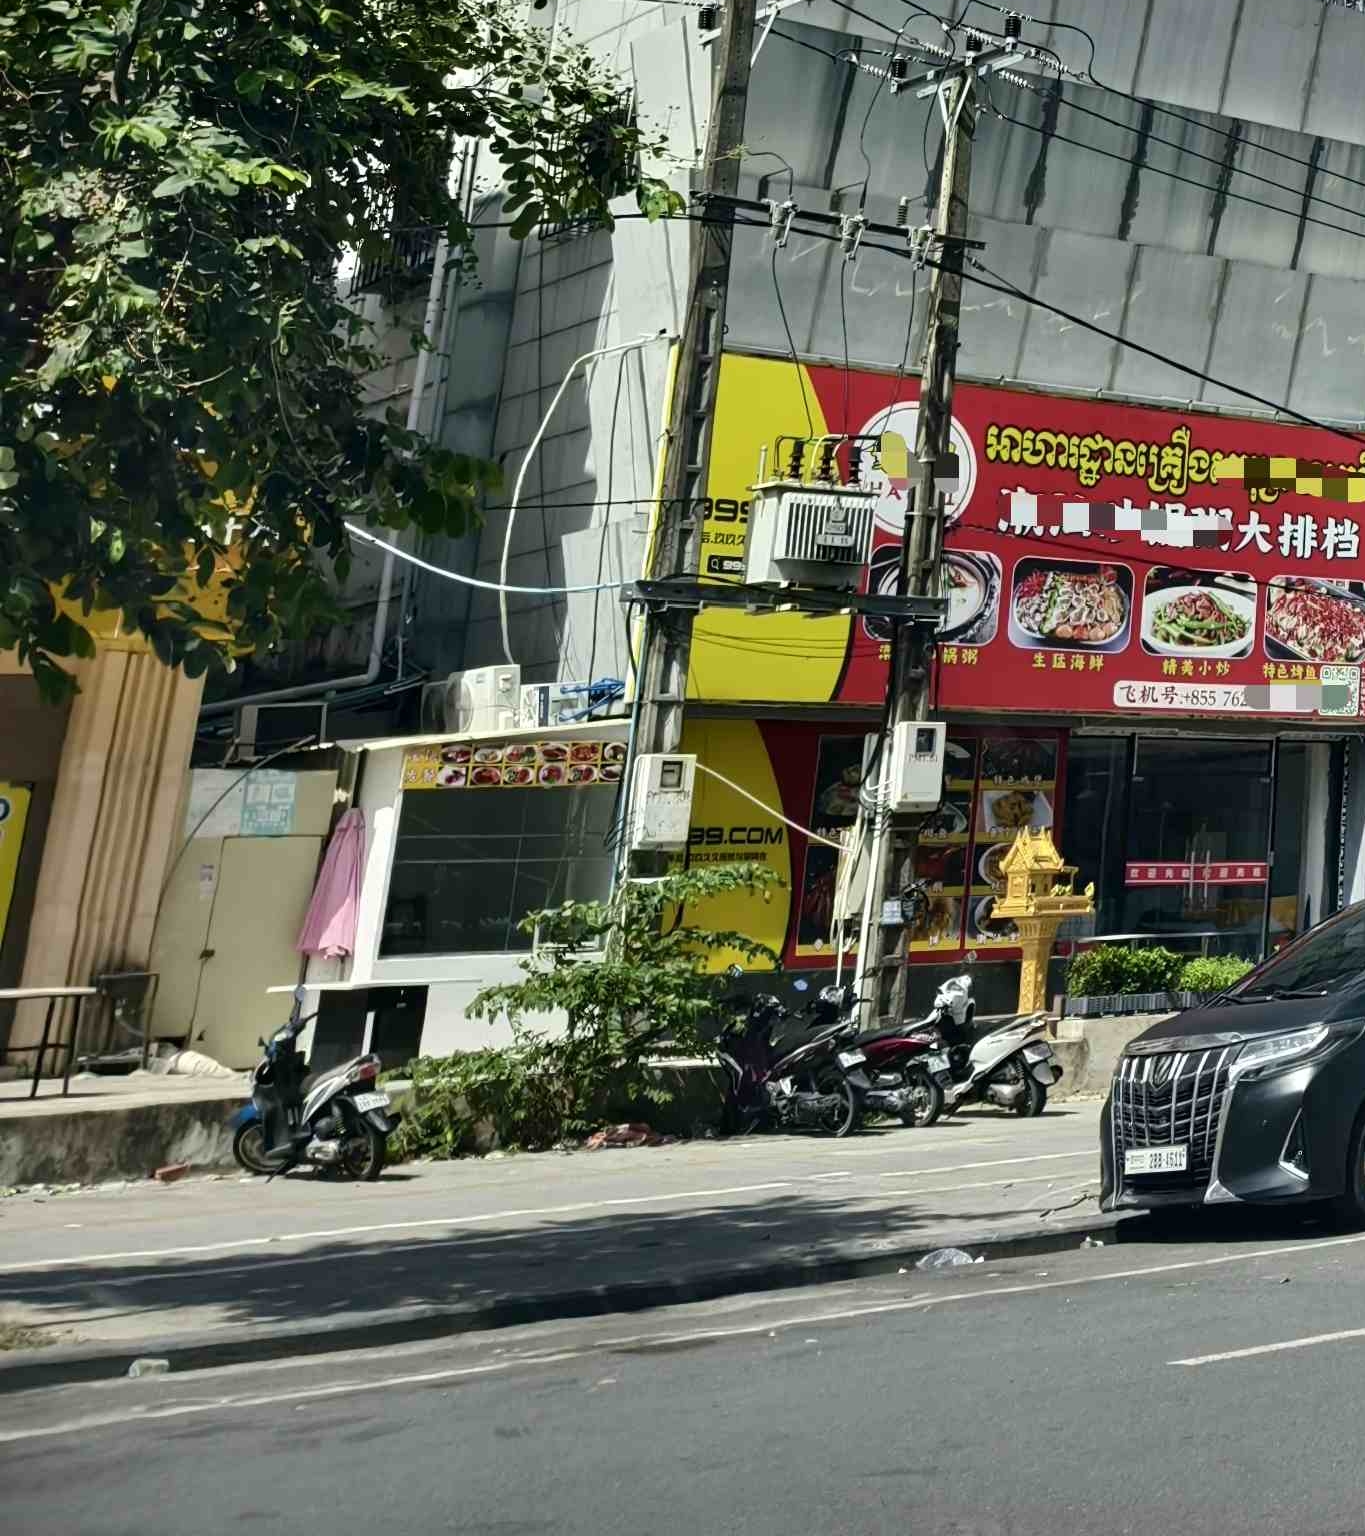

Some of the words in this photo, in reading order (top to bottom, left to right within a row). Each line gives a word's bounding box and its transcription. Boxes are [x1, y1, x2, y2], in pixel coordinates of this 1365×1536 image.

[1032, 651, 1104, 672] 生猛海鲜
[1162, 658, 1230, 676] 精美小炒
